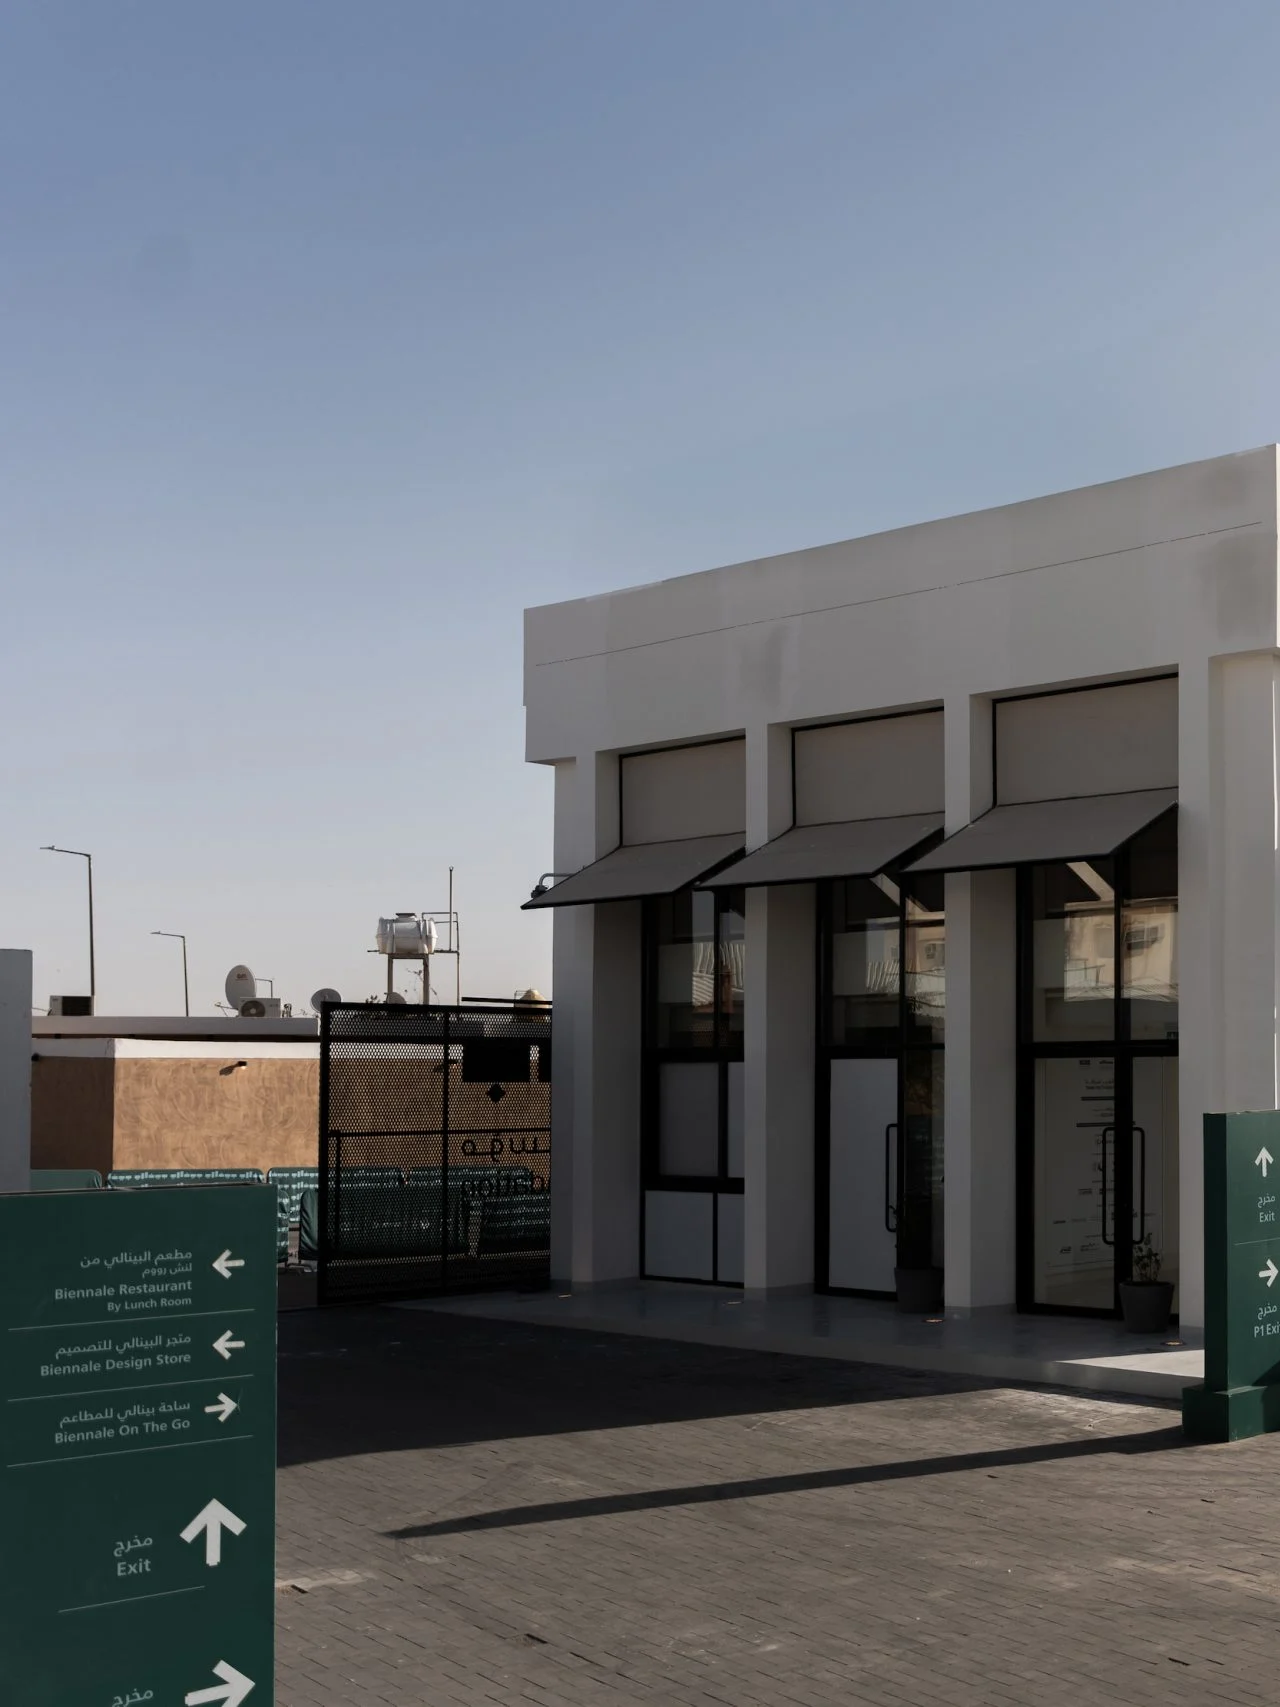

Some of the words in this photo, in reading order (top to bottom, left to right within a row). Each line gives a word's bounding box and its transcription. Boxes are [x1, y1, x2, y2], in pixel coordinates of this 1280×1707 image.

[1257, 1192, 1276, 1209] مخرج
[1259, 1210, 1276, 1223] Exit
[80, 1256, 101, 1269] من
[103, 1250, 151, 1269] البينالي
[153, 1249, 193, 1267] مطعم
[141, 1267, 167, 1279] رووم
[169, 1262, 193, 1275] لنش
[54, 1284, 115, 1300] Biennale
[119, 1280, 193, 1295] Restaurant
[107, 1301, 122, 1313] By
[124, 1298, 158, 1310] Lunch
[160, 1297, 192, 1307] Room
[1257, 1303, 1278, 1321] مخرج
[1254, 1324, 1264, 1338] P1
[55, 1339, 112, 1360] للتصميم
[115, 1335, 162, 1355] البينالي
[165, 1333, 192, 1348] متجر
[40, 1360, 102, 1377] Biennale
[105, 1356, 152, 1370] Design
[156, 1354, 191, 1366] Store
[116, 1404, 155, 1422] بينالي
[158, 1400, 191, 1412] ساحة
[59, 1407, 114, 1429] للمطاعم
[54, 1426, 115, 1444] Biennale
[118, 1424, 139, 1436] On
[142, 1421, 168, 1433] The
[171, 1418, 191, 1430] Go
[113, 1535, 153, 1558] مخرج
[117, 1558, 151, 1577] Exit
